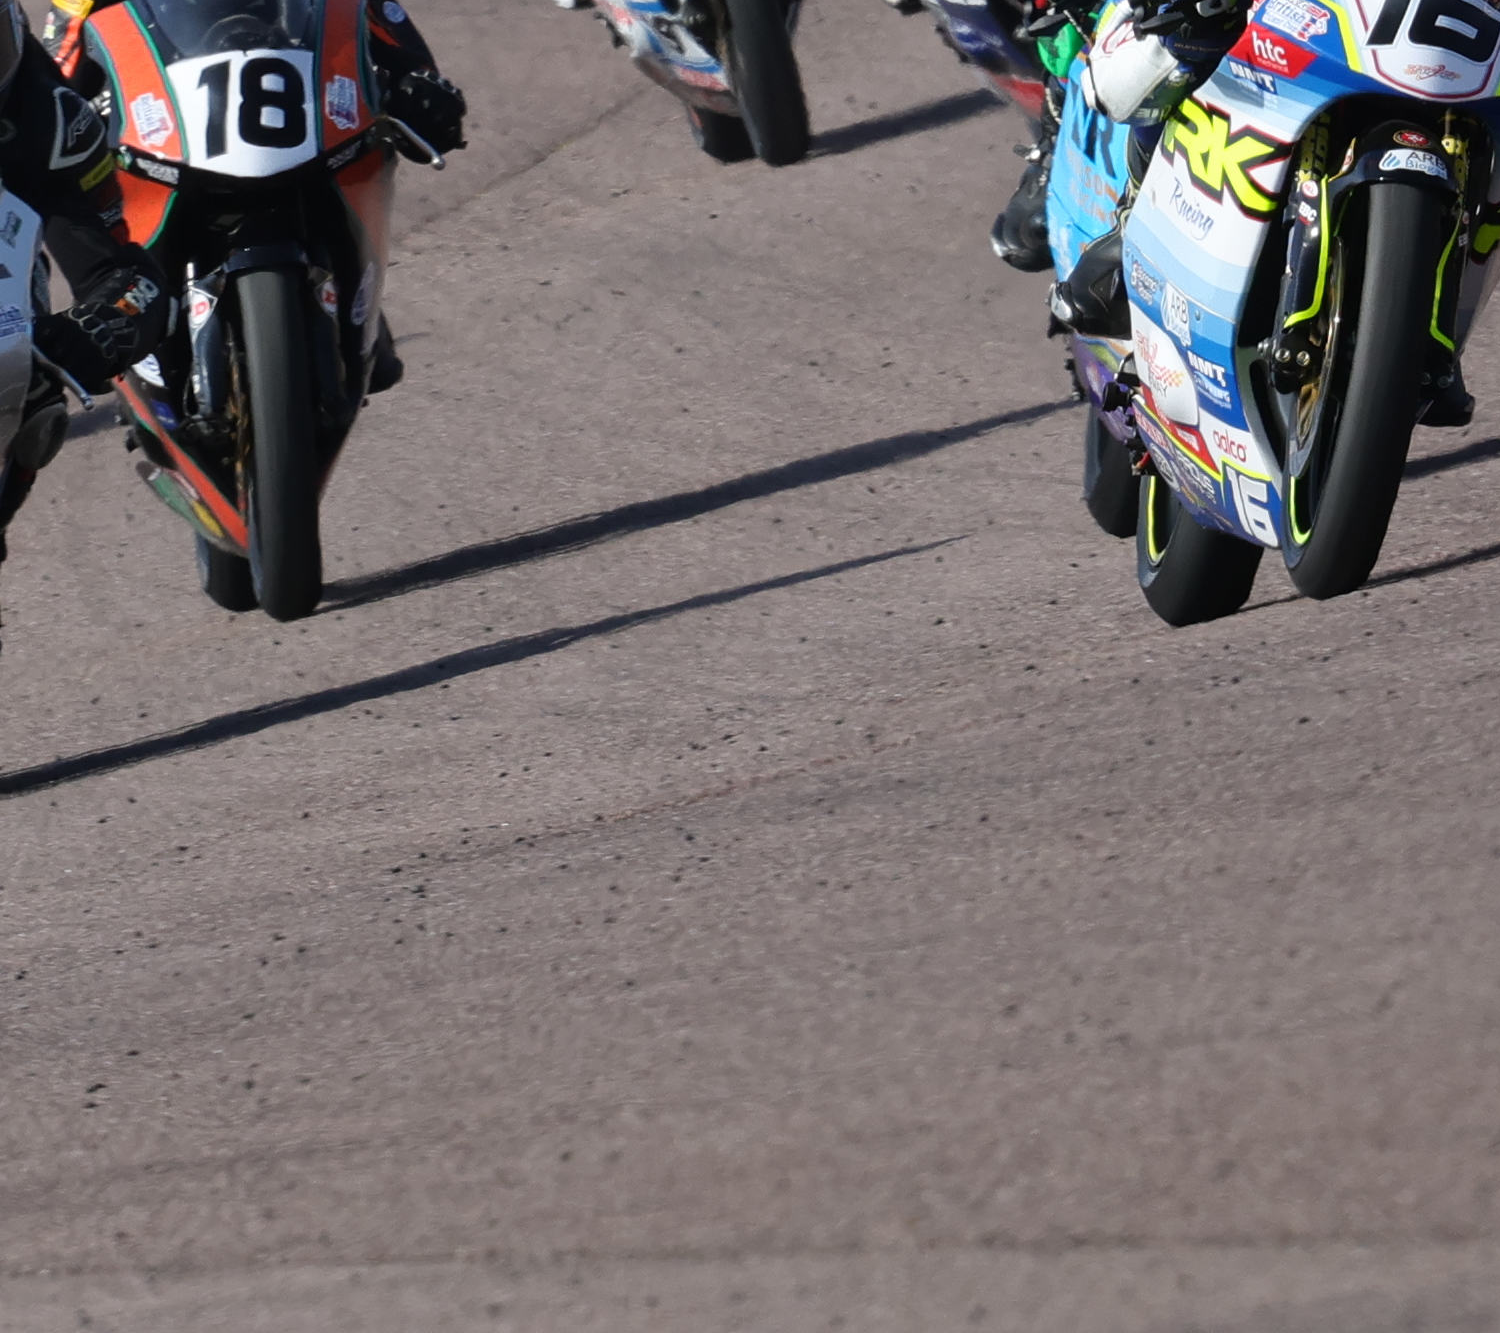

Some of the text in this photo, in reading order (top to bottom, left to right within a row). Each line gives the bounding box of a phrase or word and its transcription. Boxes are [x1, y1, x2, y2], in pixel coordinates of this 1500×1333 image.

[1229, 61, 1275, 91] NMT
[1252, 31, 1287, 65] htc
[197, 57, 306, 159] 18
[1165, 97, 1278, 215] RK
[1170, 176, 1214, 239] Racing
[1225, 465, 1280, 548] 16
